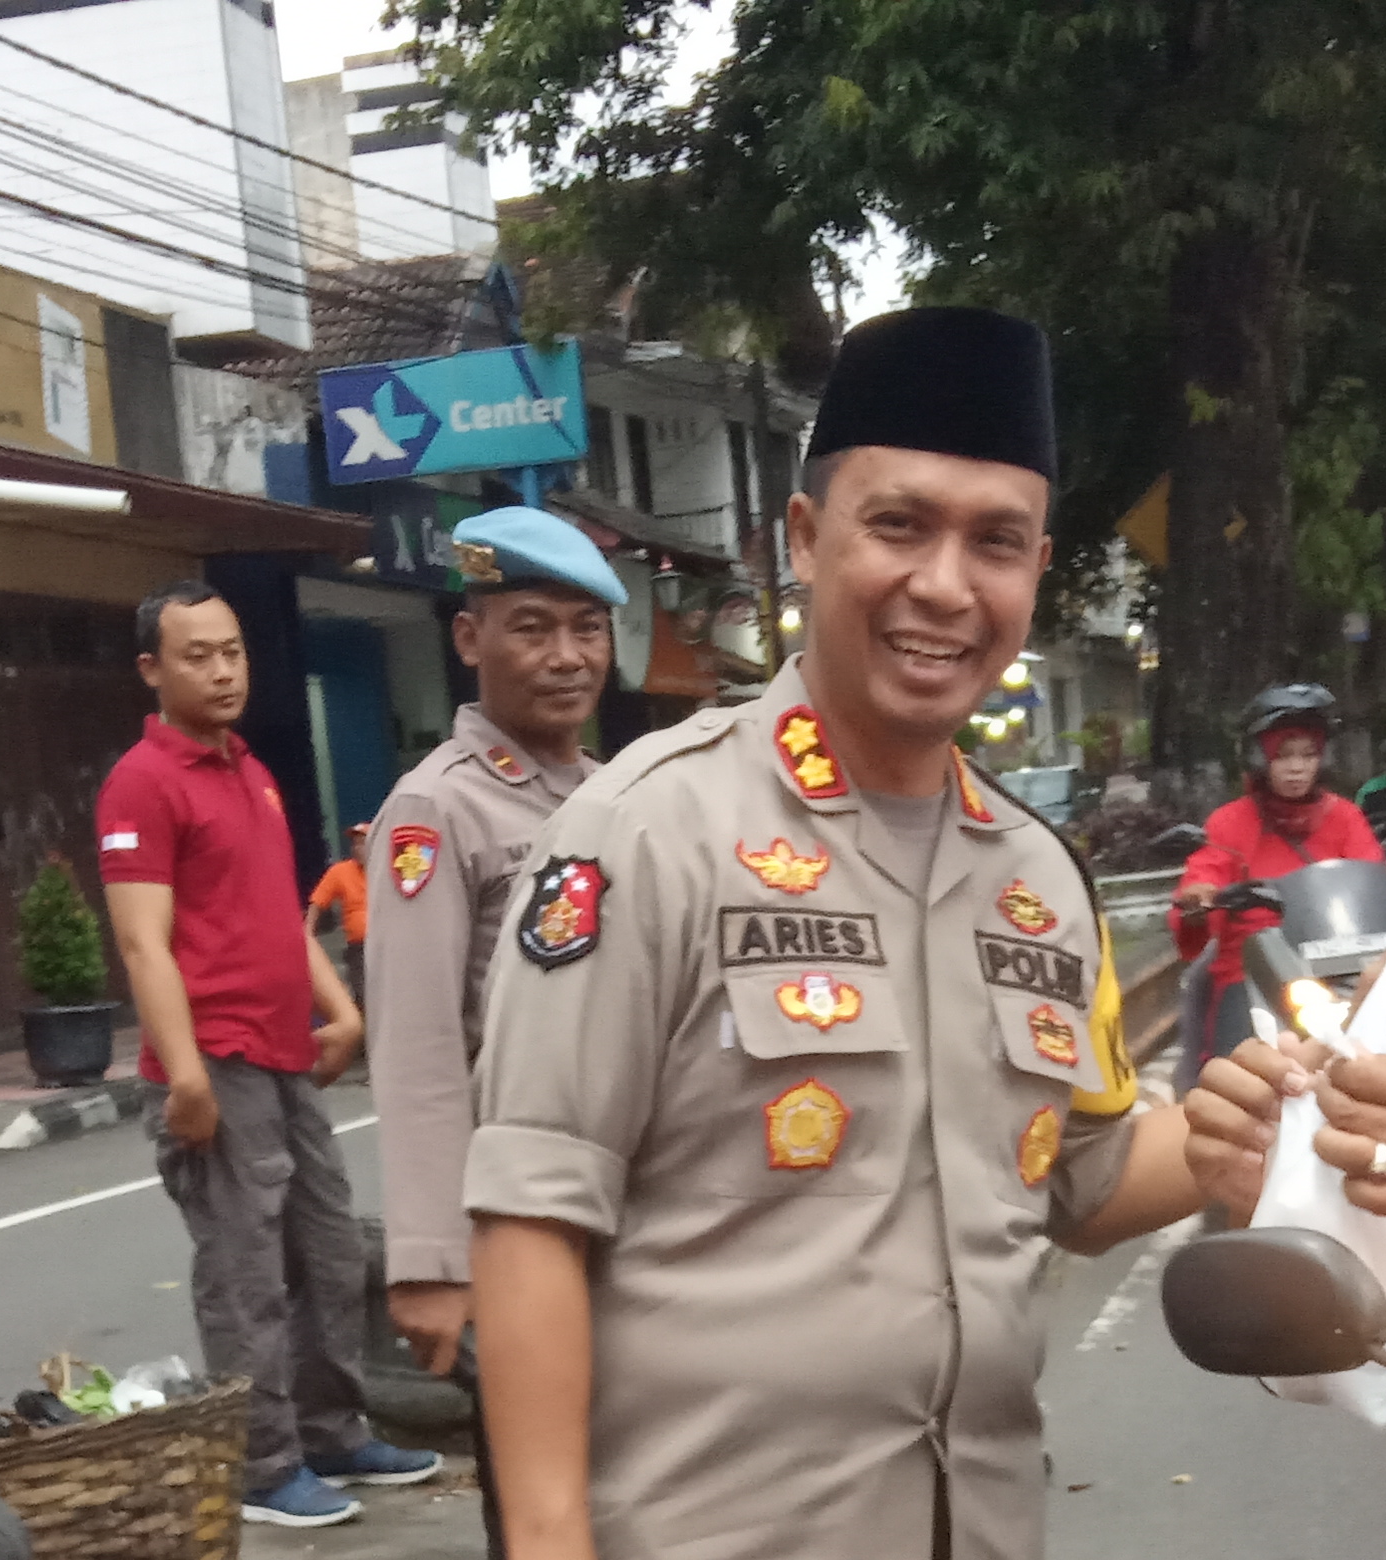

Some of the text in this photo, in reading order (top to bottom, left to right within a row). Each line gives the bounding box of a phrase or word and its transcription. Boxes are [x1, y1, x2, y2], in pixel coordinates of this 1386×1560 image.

[336, 378, 569, 467] XL Center
[738, 914, 865, 956] ARIES
